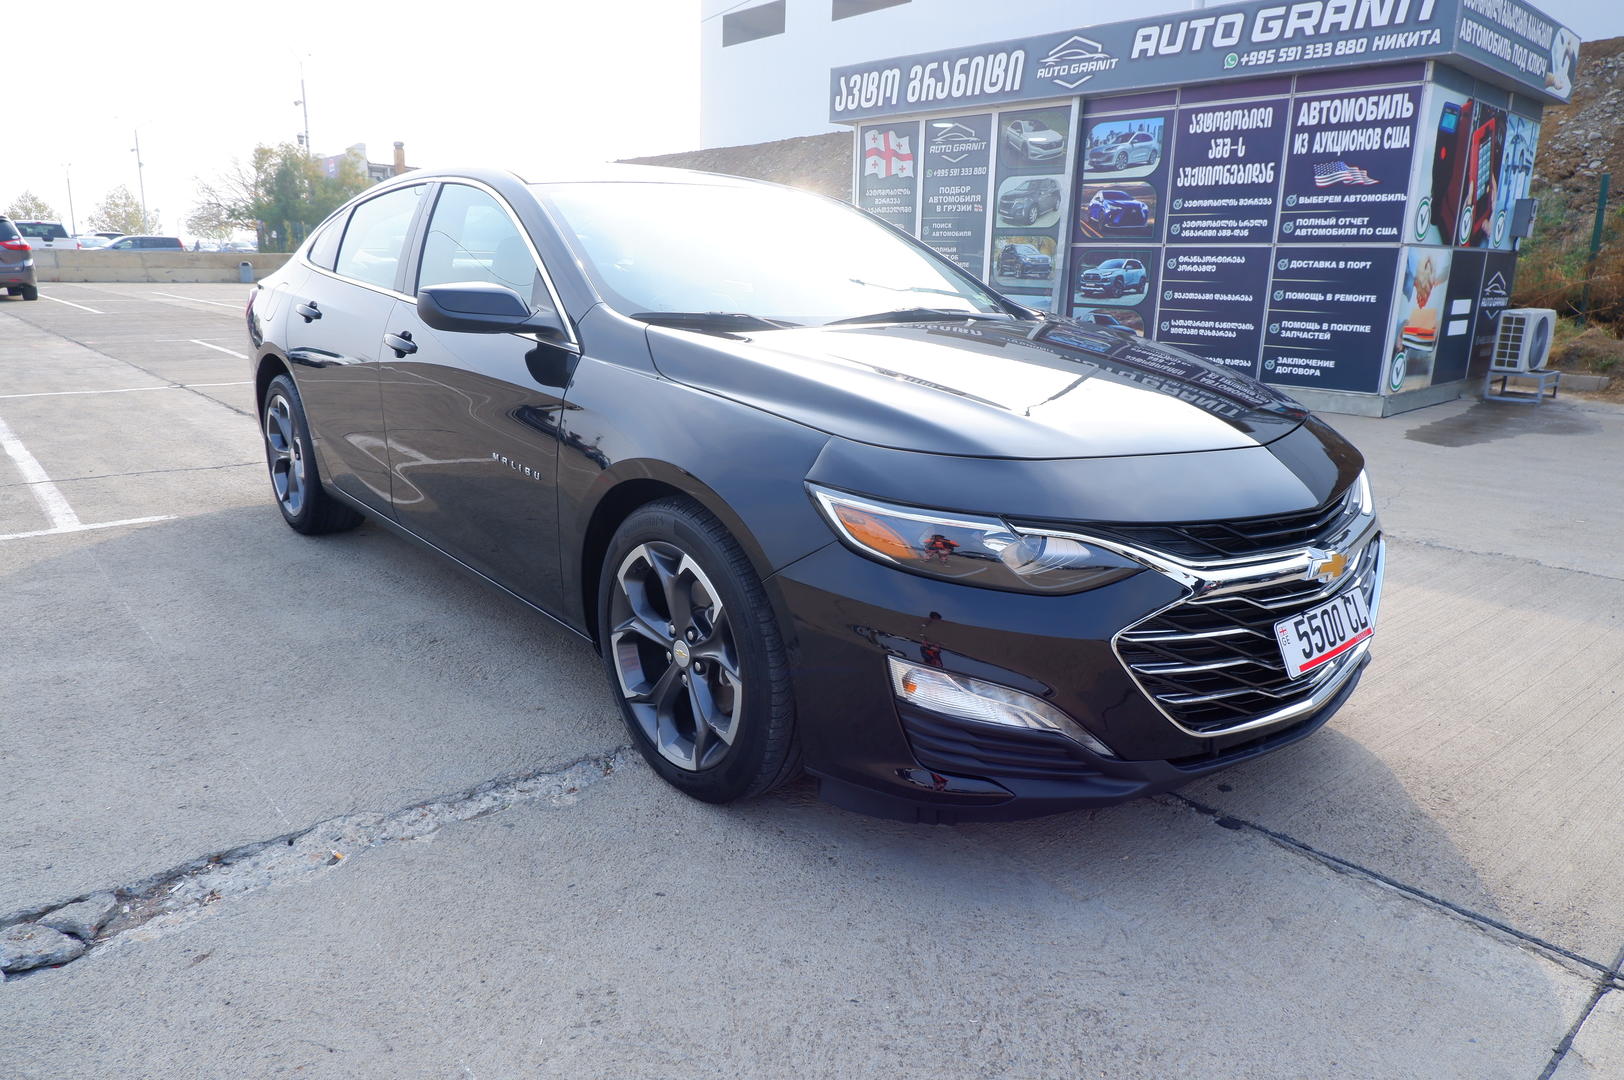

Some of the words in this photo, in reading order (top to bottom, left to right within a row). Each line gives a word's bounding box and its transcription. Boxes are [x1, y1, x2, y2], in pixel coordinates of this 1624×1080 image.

[1131, 12, 1245, 58] AUTO
[1251, 0, 1438, 43] GRANIT
[1240, 49, 1276, 66] +995
[1278, 46, 1301, 63] 591
[1304, 42, 1332, 59] 333
[1335, 38, 1366, 56] 880
[1372, 28, 1441, 52] НИКИТА
[1459, 17, 1512, 61] АВТОМОБИЛЬ
[1511, 43, 1529, 73] ПОД
[1526, 52, 1547, 78] КЛЮЧ
[1036, 65, 1068, 80] AUTO
[1070, 58, 1119, 75] GRANIT
[834, 68, 900, 112] ავტო
[907, 50, 1025, 102] გრანიტი
[1297, 93, 1414, 127] АВТОМОБИЛЬ
[1189, 107, 1273, 134] ავტომობილი
[1293, 132, 1309, 155] ИЗ
[1312, 127, 1381, 156] АУКЦИОНОВ
[1383, 125, 1411, 150] США
[929, 144, 952, 154] AUTO
[953, 142, 987, 152] GRANIT
[1177, 162, 1275, 187] აუქციონებიდან
[939, 186, 971, 195] ПОДБОР
[929, 195, 981, 203] АВТОМОБИЛЯ
[1298, 195, 1342, 204] ВЫБЕРЕМ
[1343, 193, 1408, 203] АВТОМОБИЛЬ
[943, 204, 972, 212] ГРУЗИИ
[1296, 217, 1336, 226] ПОЛНЫЙ
[1338, 217, 1369, 225] ОТЧЕТ
[1294, 227, 1358, 236] АВТОМОБИЛЯ
[1359, 227, 1374, 235] ПО
[1375, 227, 1398, 235] США
[1290, 260, 1337, 269] ДОСТАВКА
[1347, 261, 1372, 269] ПОРТ
[1285, 292, 1324, 301] ПОМОЩЬ
[1326, 293, 1333, 301] В
[1334, 294, 1377, 303] РЕМОНТЕ
[1281, 321, 1320, 330] ПОМОЩЬ
[1322, 322, 1328, 330] В
[1330, 323, 1372, 333] ПОКУПКЕ
[1280, 330, 1331, 340] ЗАПЧАСТЕЙ
[1276, 356, 1336, 368] ЗАКЛЮЧЕНИЕ
[1275, 366, 1321, 376] ДОГОВОРА
[492, 452, 540, 480] MALIBU
[1293, 603, 1345, 659] 5500
